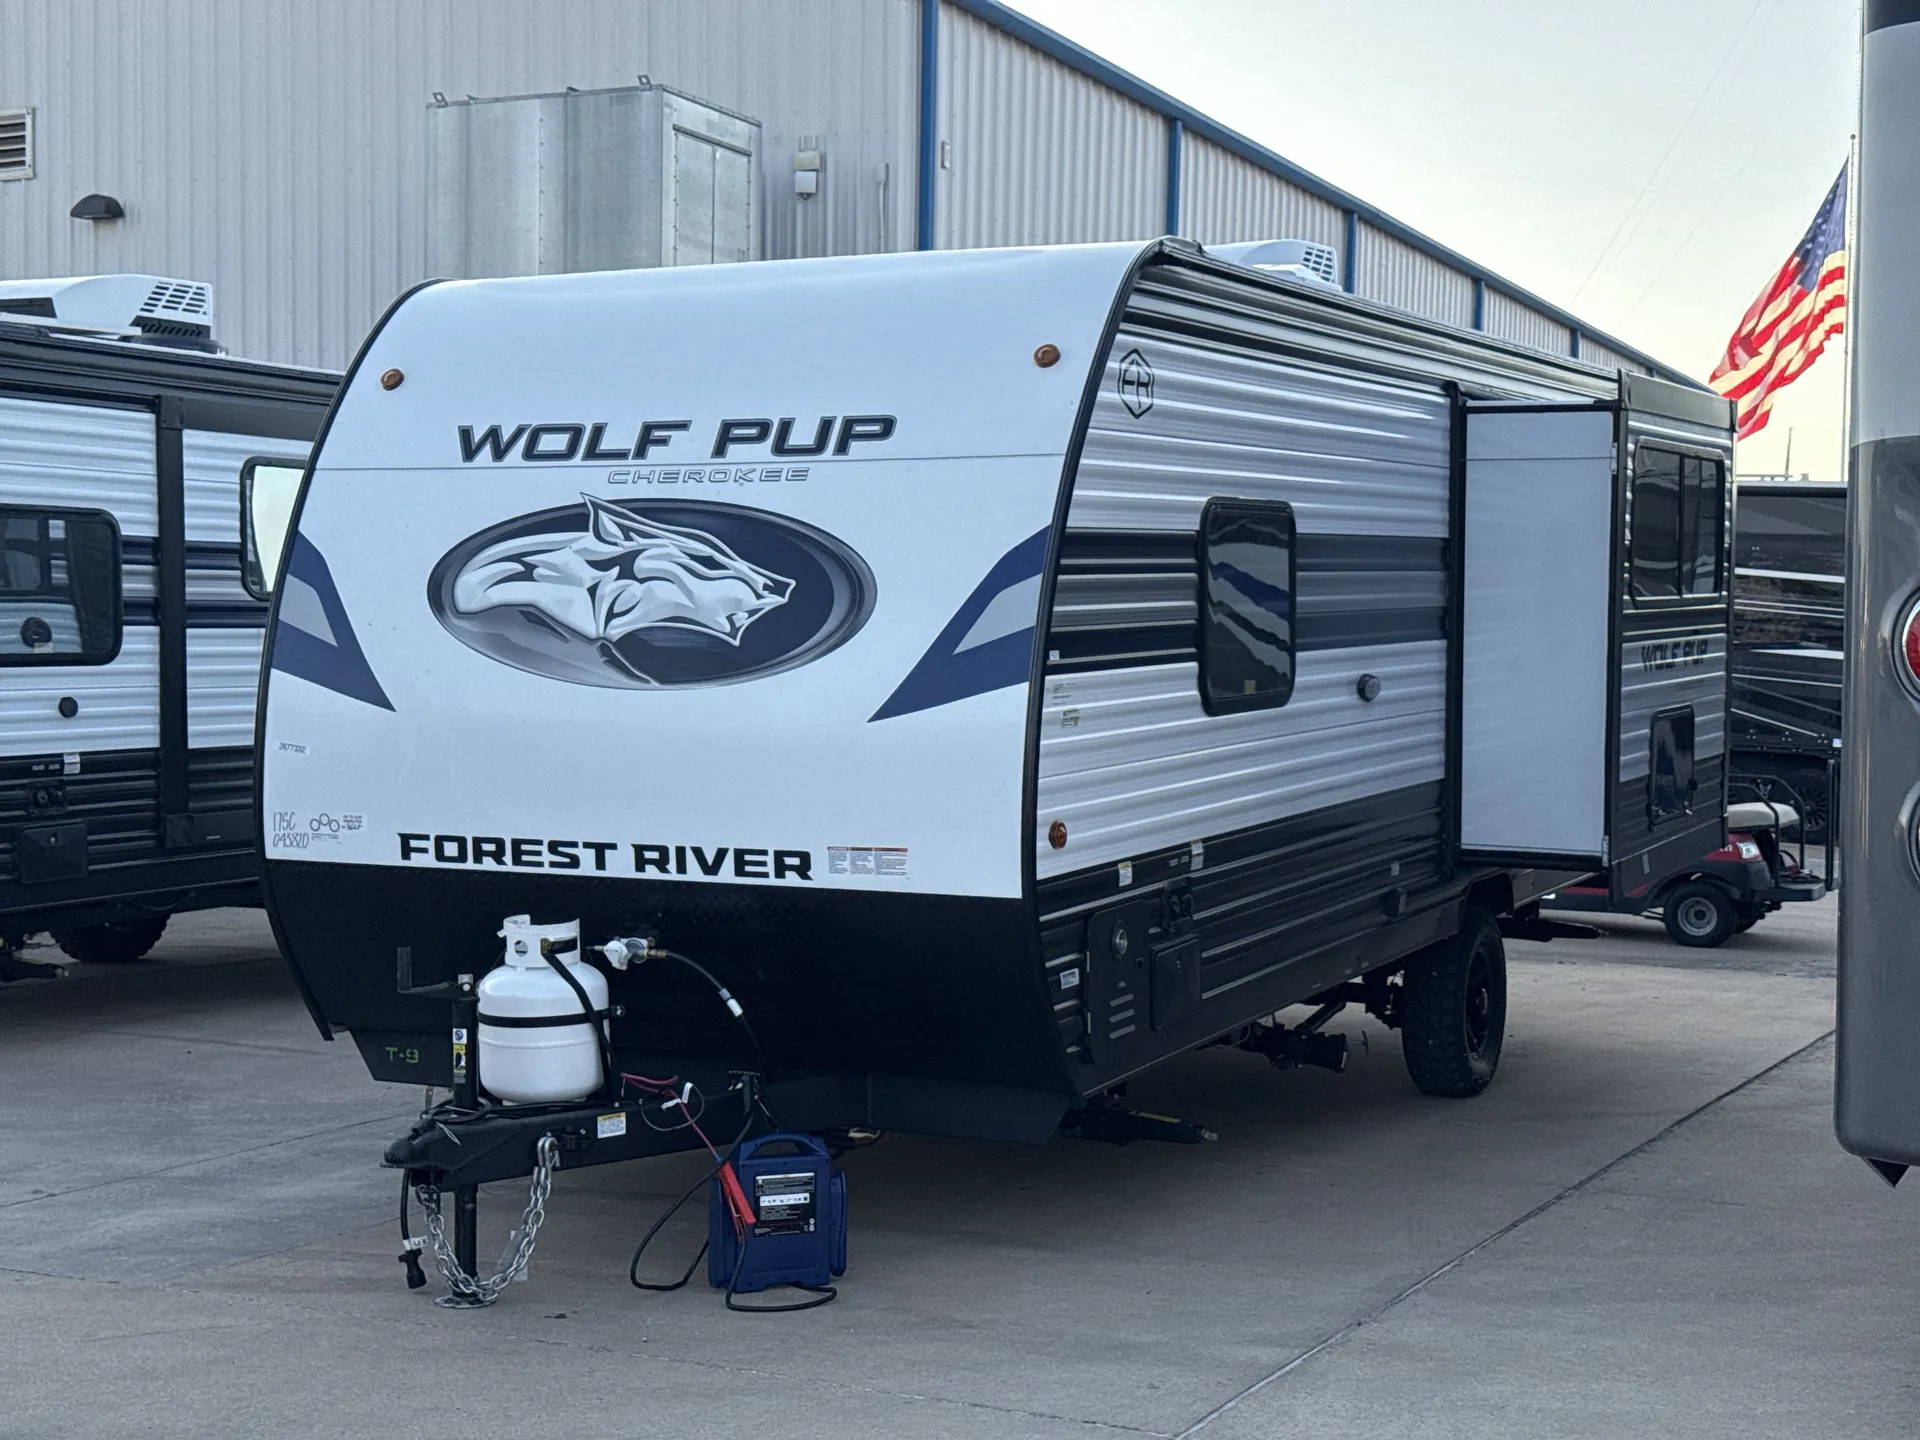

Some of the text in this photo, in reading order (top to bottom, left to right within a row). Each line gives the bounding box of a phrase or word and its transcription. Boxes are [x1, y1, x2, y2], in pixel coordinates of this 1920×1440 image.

[458, 415, 898, 463] WOLF PUP
[607, 466, 810, 485] CHEROKEE
[1641, 638, 1709, 673] WOLF PUP
[397, 833, 618, 871] FOREST
[630, 844, 814, 881] RIVER
